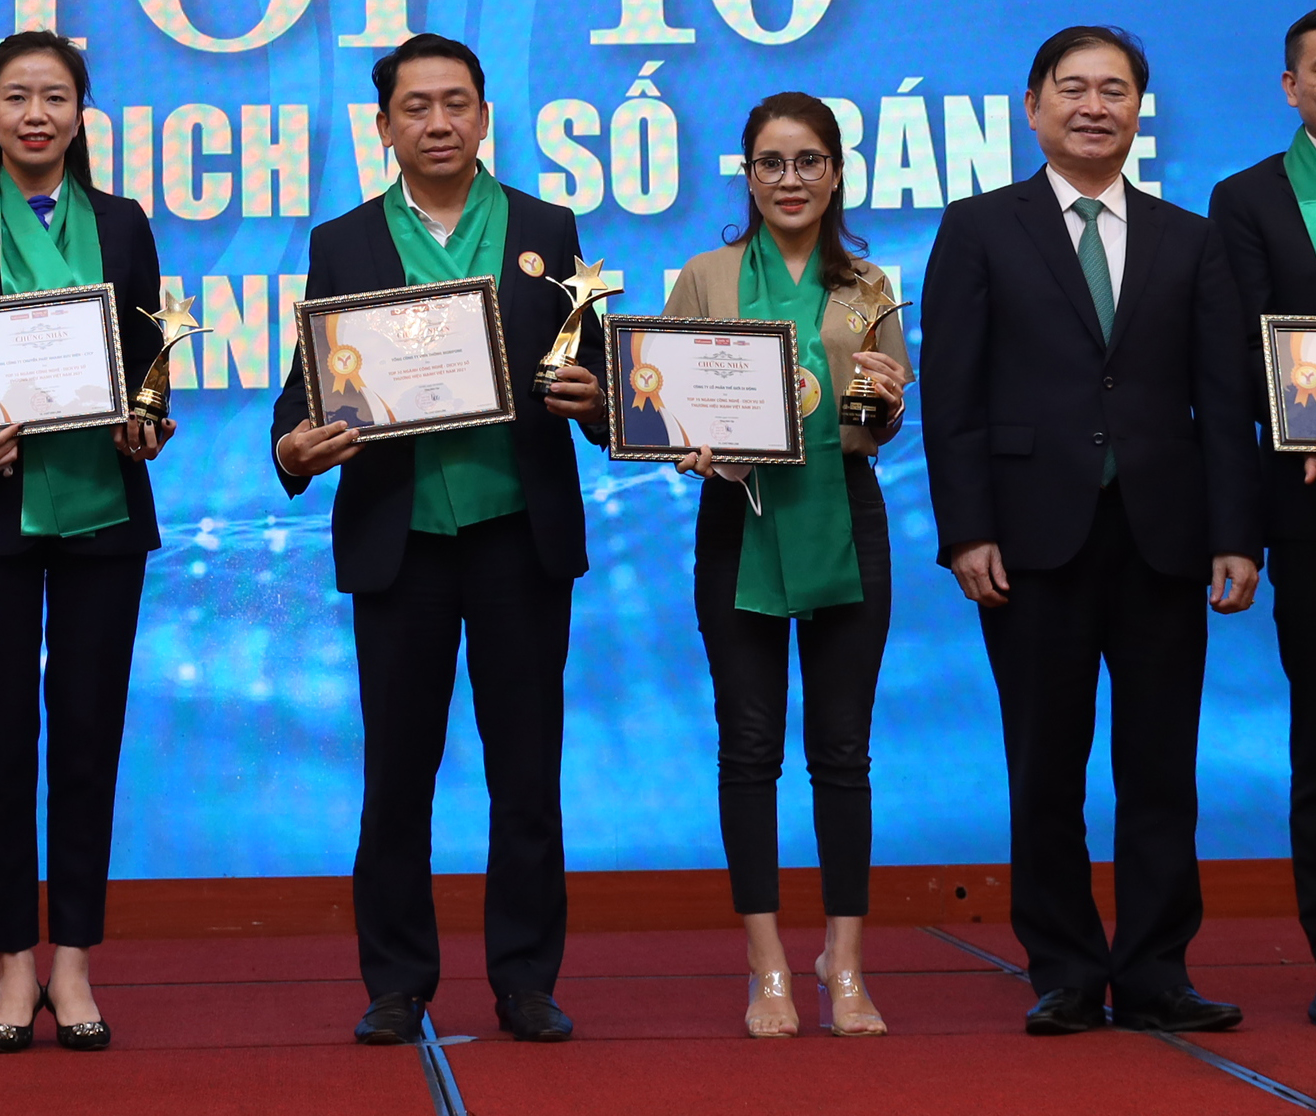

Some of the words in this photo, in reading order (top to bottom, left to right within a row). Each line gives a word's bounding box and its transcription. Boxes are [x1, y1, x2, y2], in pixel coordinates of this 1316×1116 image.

[535, 61, 680, 216] SỐ
[15, 334, 43, 343] CHỨNG
[46, 331, 68, 340] NHẬN
